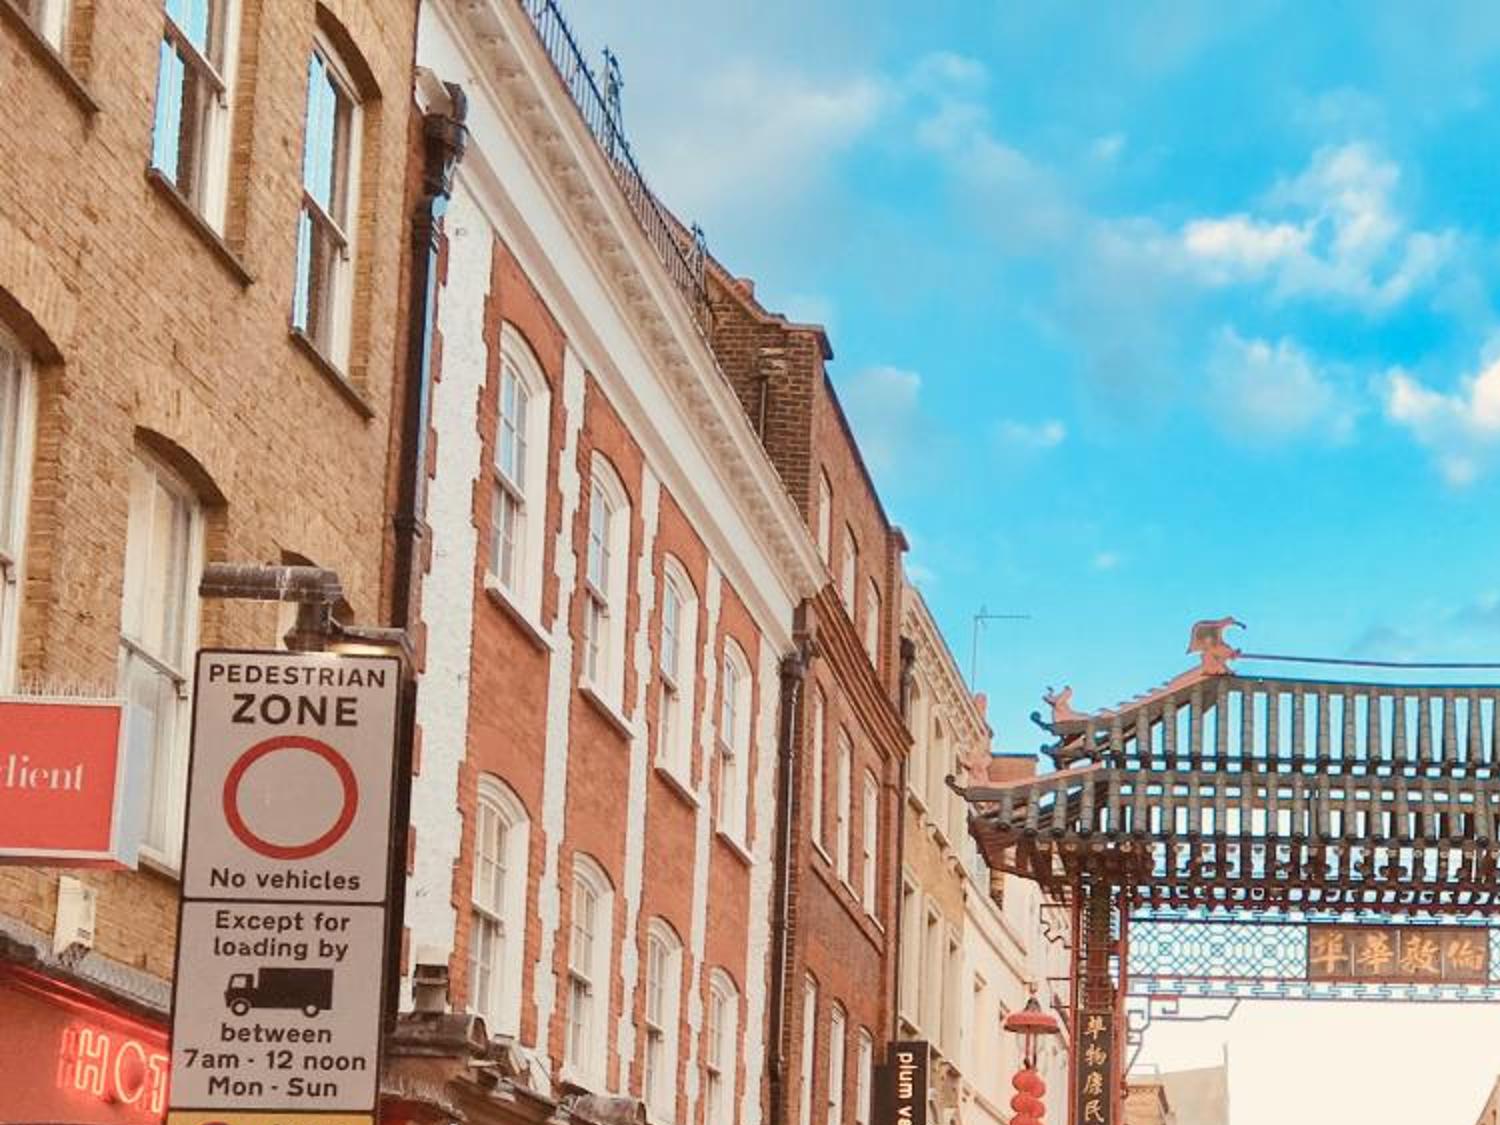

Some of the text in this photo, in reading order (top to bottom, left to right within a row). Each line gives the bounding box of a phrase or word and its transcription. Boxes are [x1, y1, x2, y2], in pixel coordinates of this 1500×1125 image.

[208, 663, 386, 688] PEDESTRIAN
[231, 692, 359, 727] ZONE
[209, 867, 361, 891] No vehicles
[215, 909, 350, 933] Except for
[213, 937, 349, 962] loading by
[220, 1023, 333, 1044] between
[183, 1048, 240, 1070] 7am
[265, 1050, 293, 1070] 12
[302, 1054, 367, 1072] noon
[207, 1075, 263, 1097] Mon
[286, 1077, 338, 1098] Sun
[896, 1052, 919, 1100] plum
